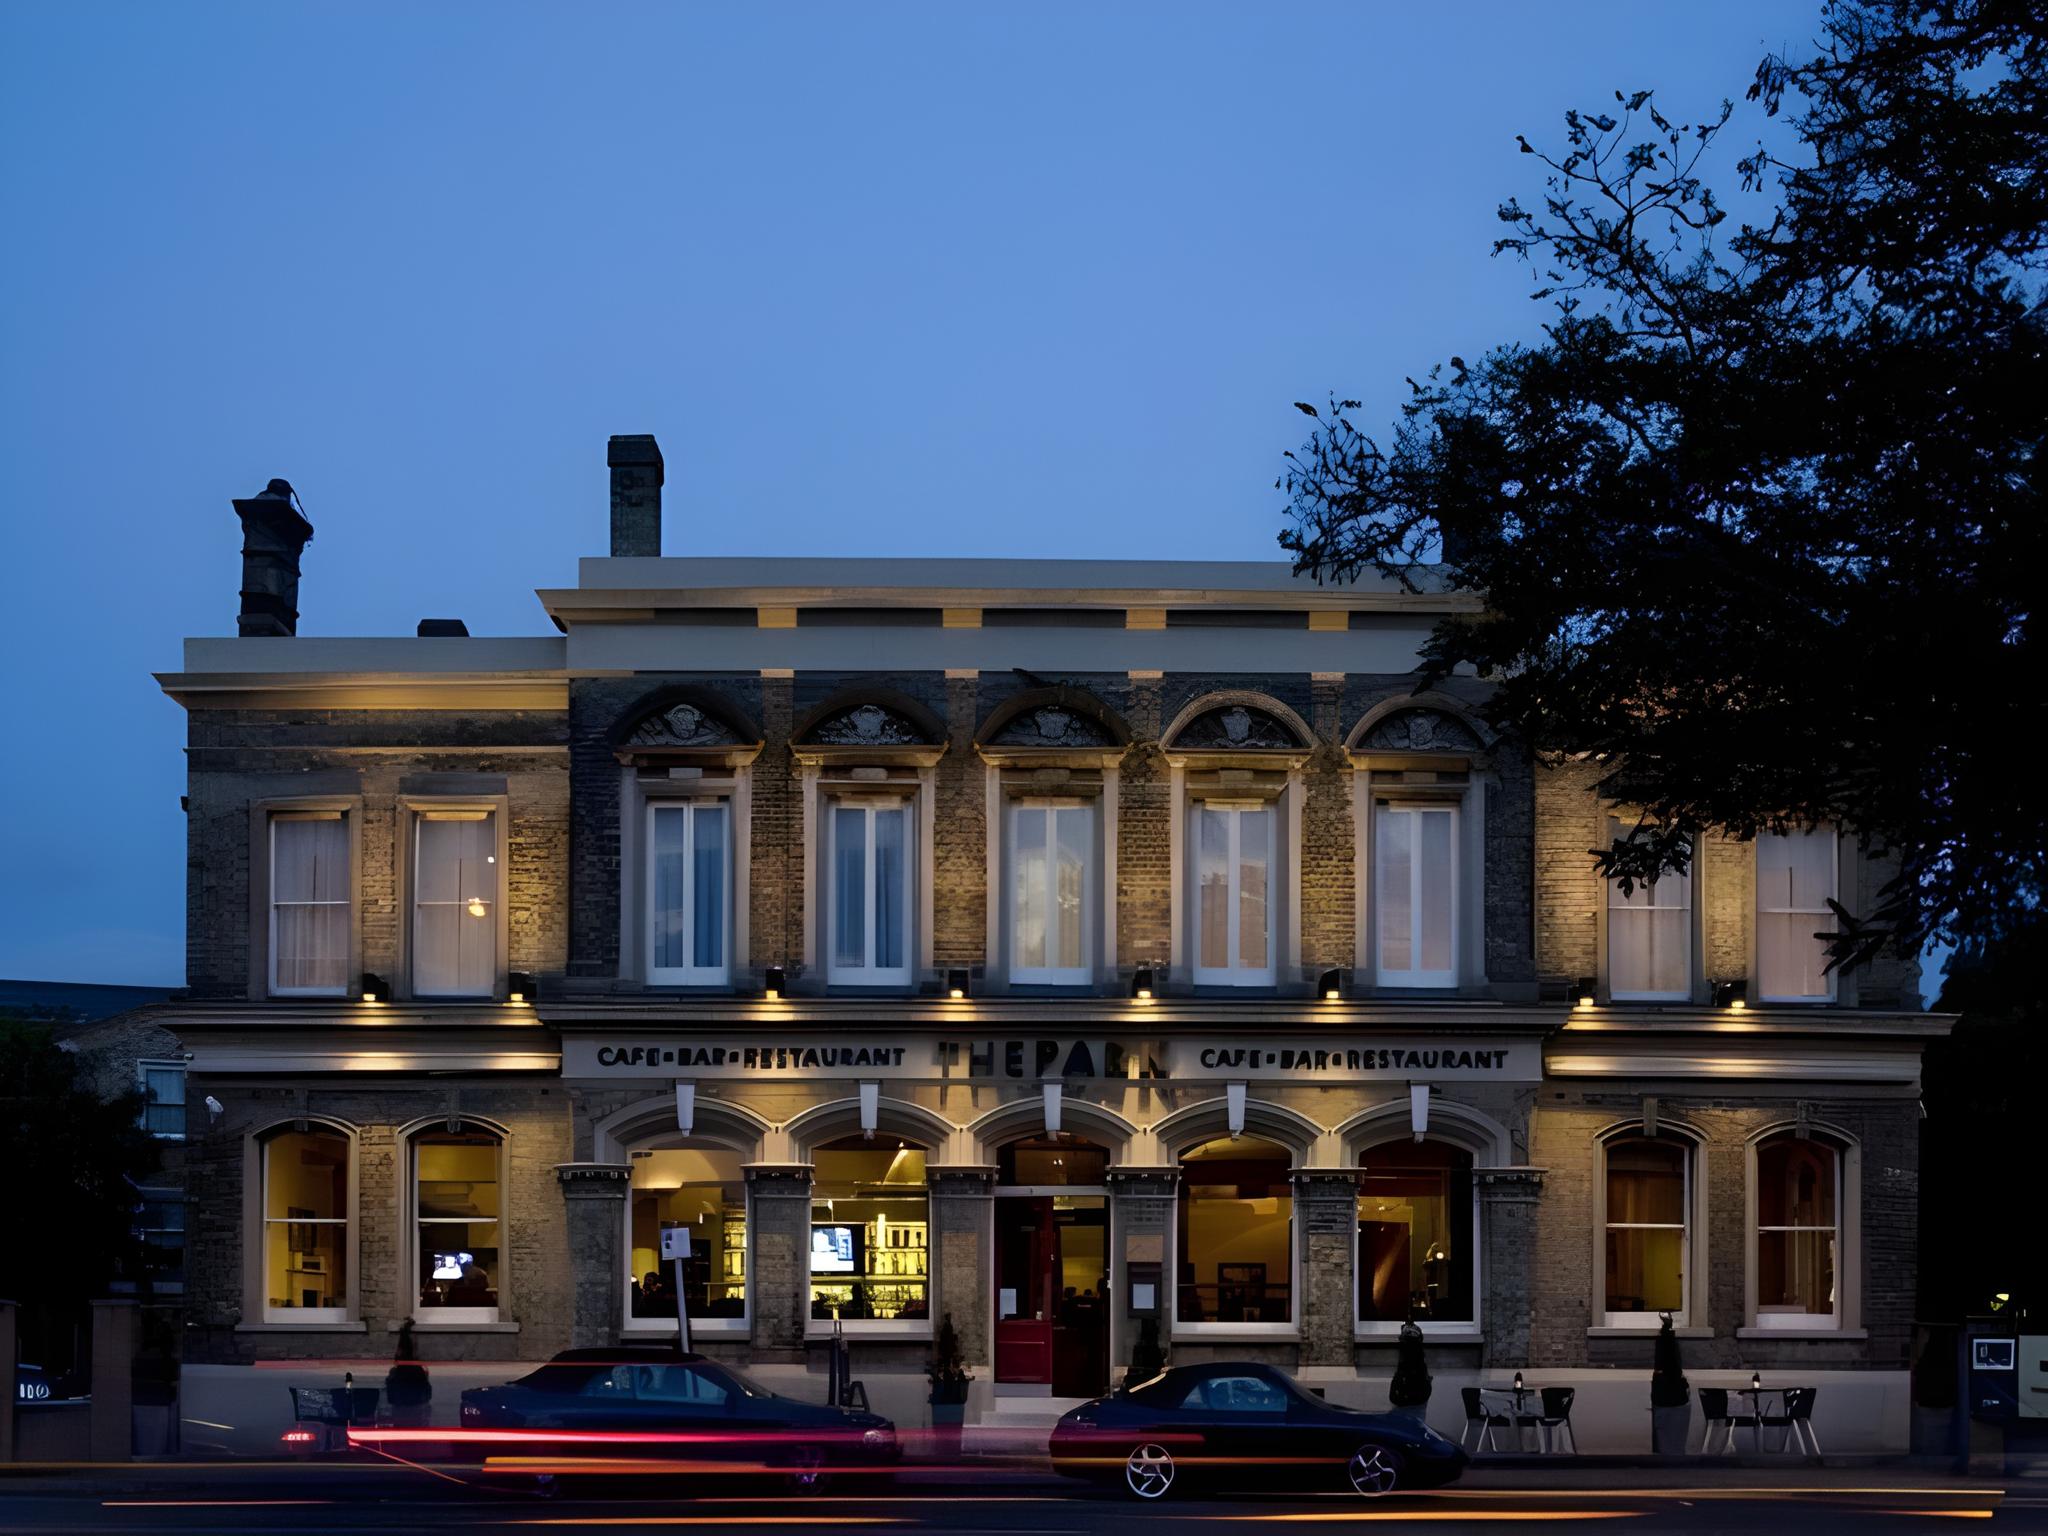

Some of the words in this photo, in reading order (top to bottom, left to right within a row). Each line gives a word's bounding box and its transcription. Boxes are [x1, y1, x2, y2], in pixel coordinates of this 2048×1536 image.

[597, 1047, 660, 1067] CAFE
[677, 1048, 726, 1067] BAR
[743, 1047, 905, 1069] RESTAURANT
[1200, 1048, 1261, 1069] CAFE
[1280, 1050, 1328, 1070] BAR
[1346, 1049, 1509, 1070] RESTAURANT
